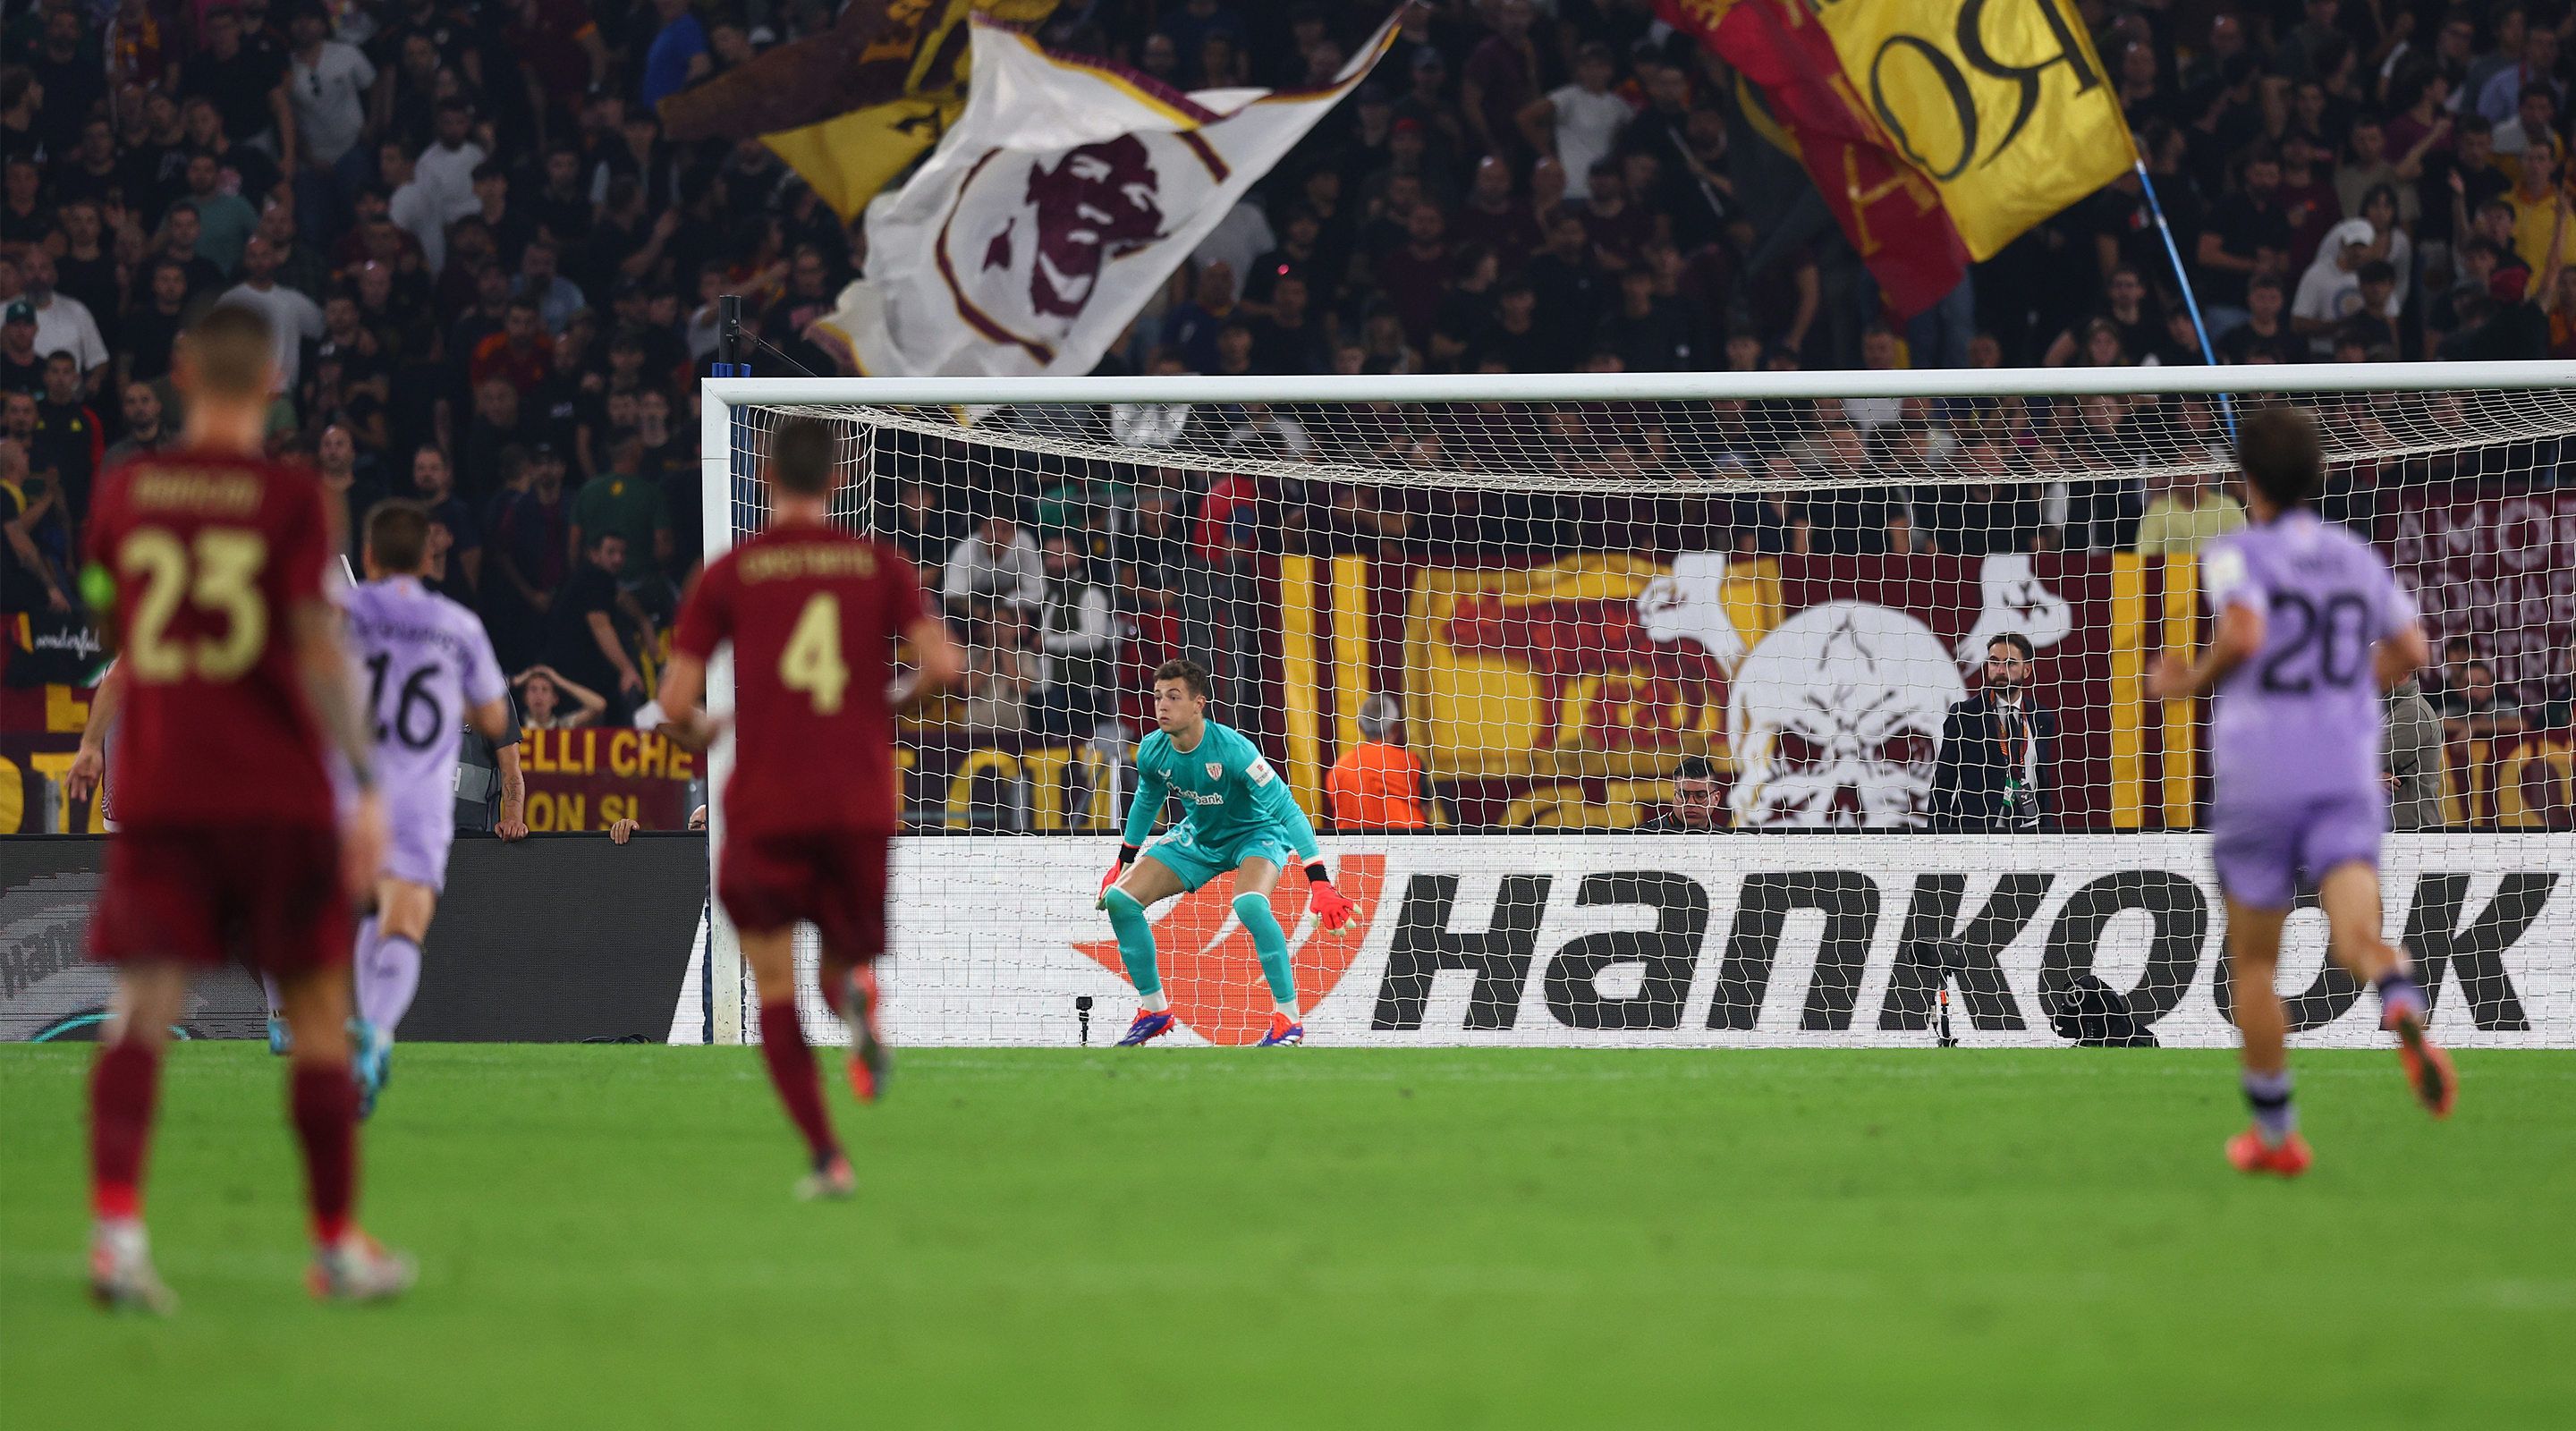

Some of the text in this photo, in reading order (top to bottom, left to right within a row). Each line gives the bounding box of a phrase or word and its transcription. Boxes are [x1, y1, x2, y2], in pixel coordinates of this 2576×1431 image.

[120, 528, 268, 682] 23
[778, 593, 849, 714] 4
[2261, 593, 2368, 693] 20
[367, 652, 442, 749] 16
[609, 731, 693, 781] CHE
[501, 791, 586, 831] ON
